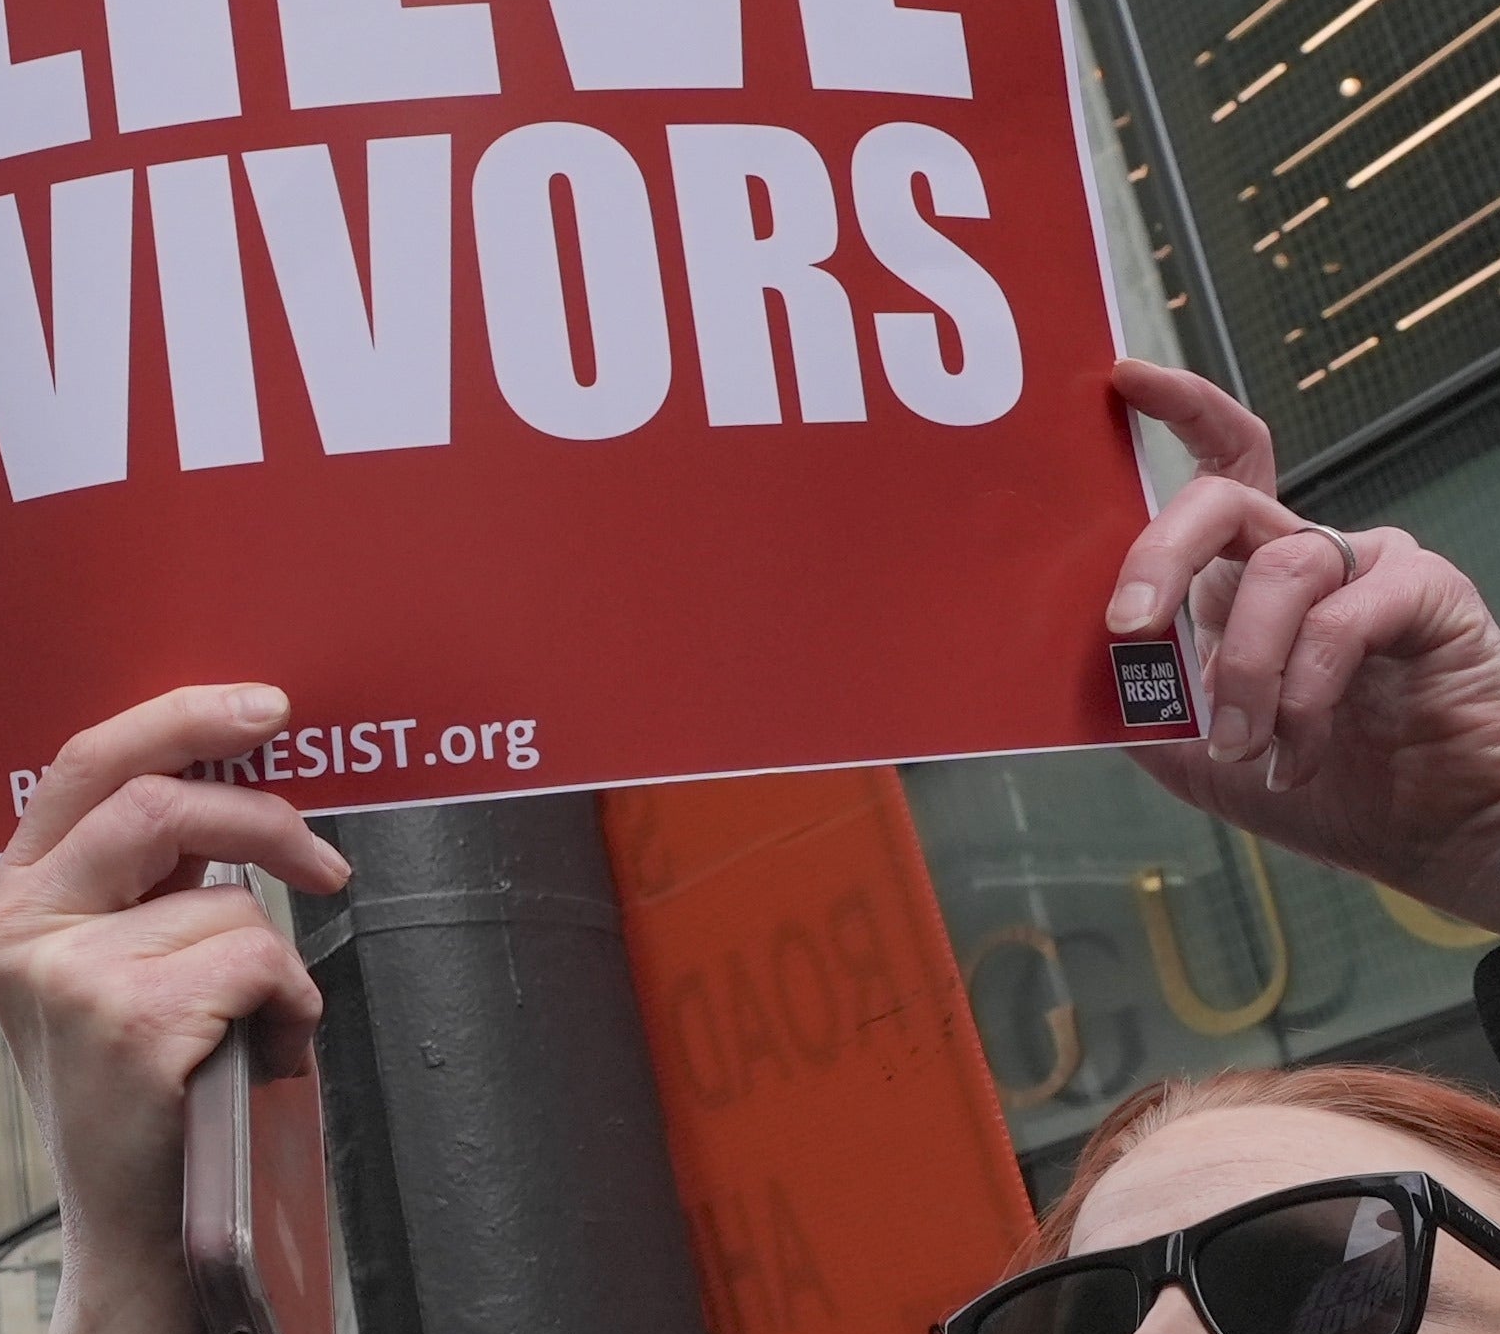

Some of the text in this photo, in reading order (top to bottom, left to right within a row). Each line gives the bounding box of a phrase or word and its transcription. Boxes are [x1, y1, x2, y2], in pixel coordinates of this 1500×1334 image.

[1121, 663, 1175, 680] RISE AND
[1124, 679, 1177, 702] RESIST
[1160, 701, 1183, 720] .org
